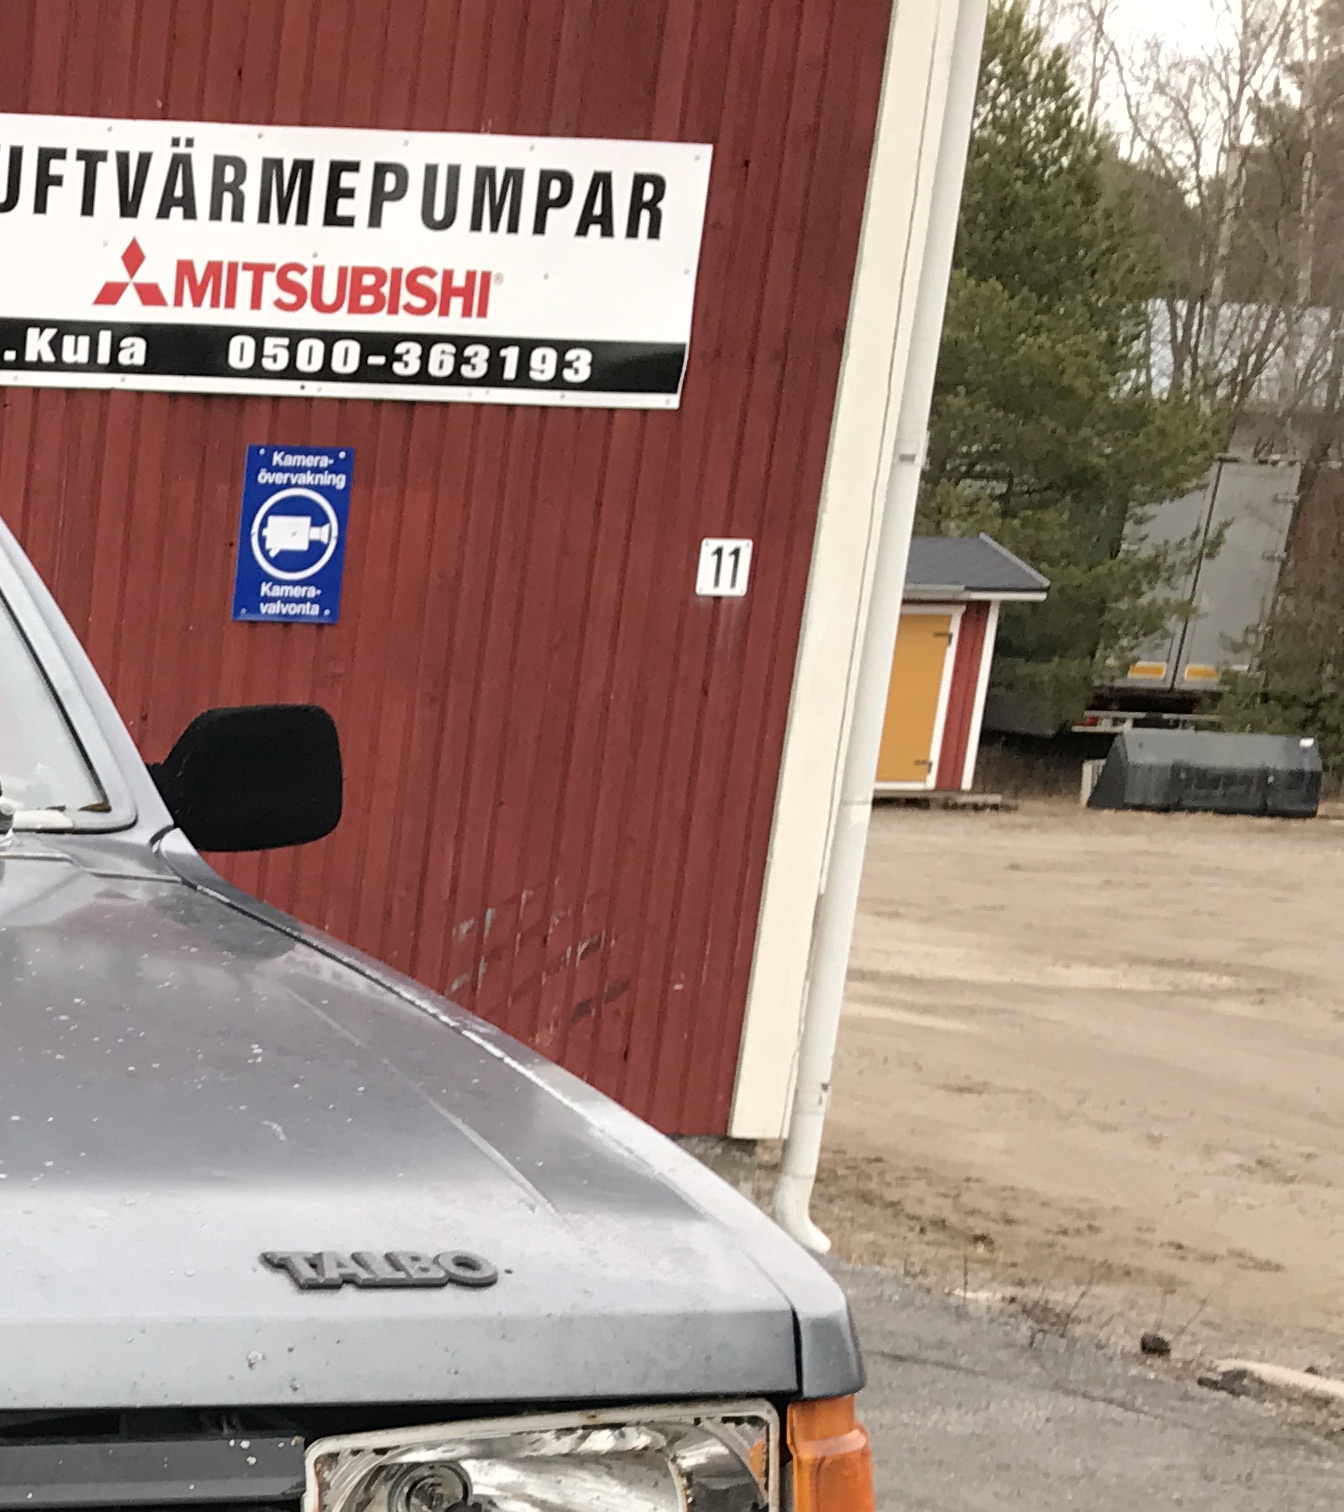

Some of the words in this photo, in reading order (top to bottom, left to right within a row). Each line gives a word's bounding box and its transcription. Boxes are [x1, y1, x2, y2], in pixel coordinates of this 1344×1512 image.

[173, 259, 493, 319] MITSUBISHI
[227, 334, 593, 383] 0500-363193
[272, 451, 334, 467] Kamera-
[257, 468, 346, 490] övervakning
[711, 544, 742, 589] 11
[260, 581, 322, 598] Kamera-
[260, 600, 320, 616] valvonta
